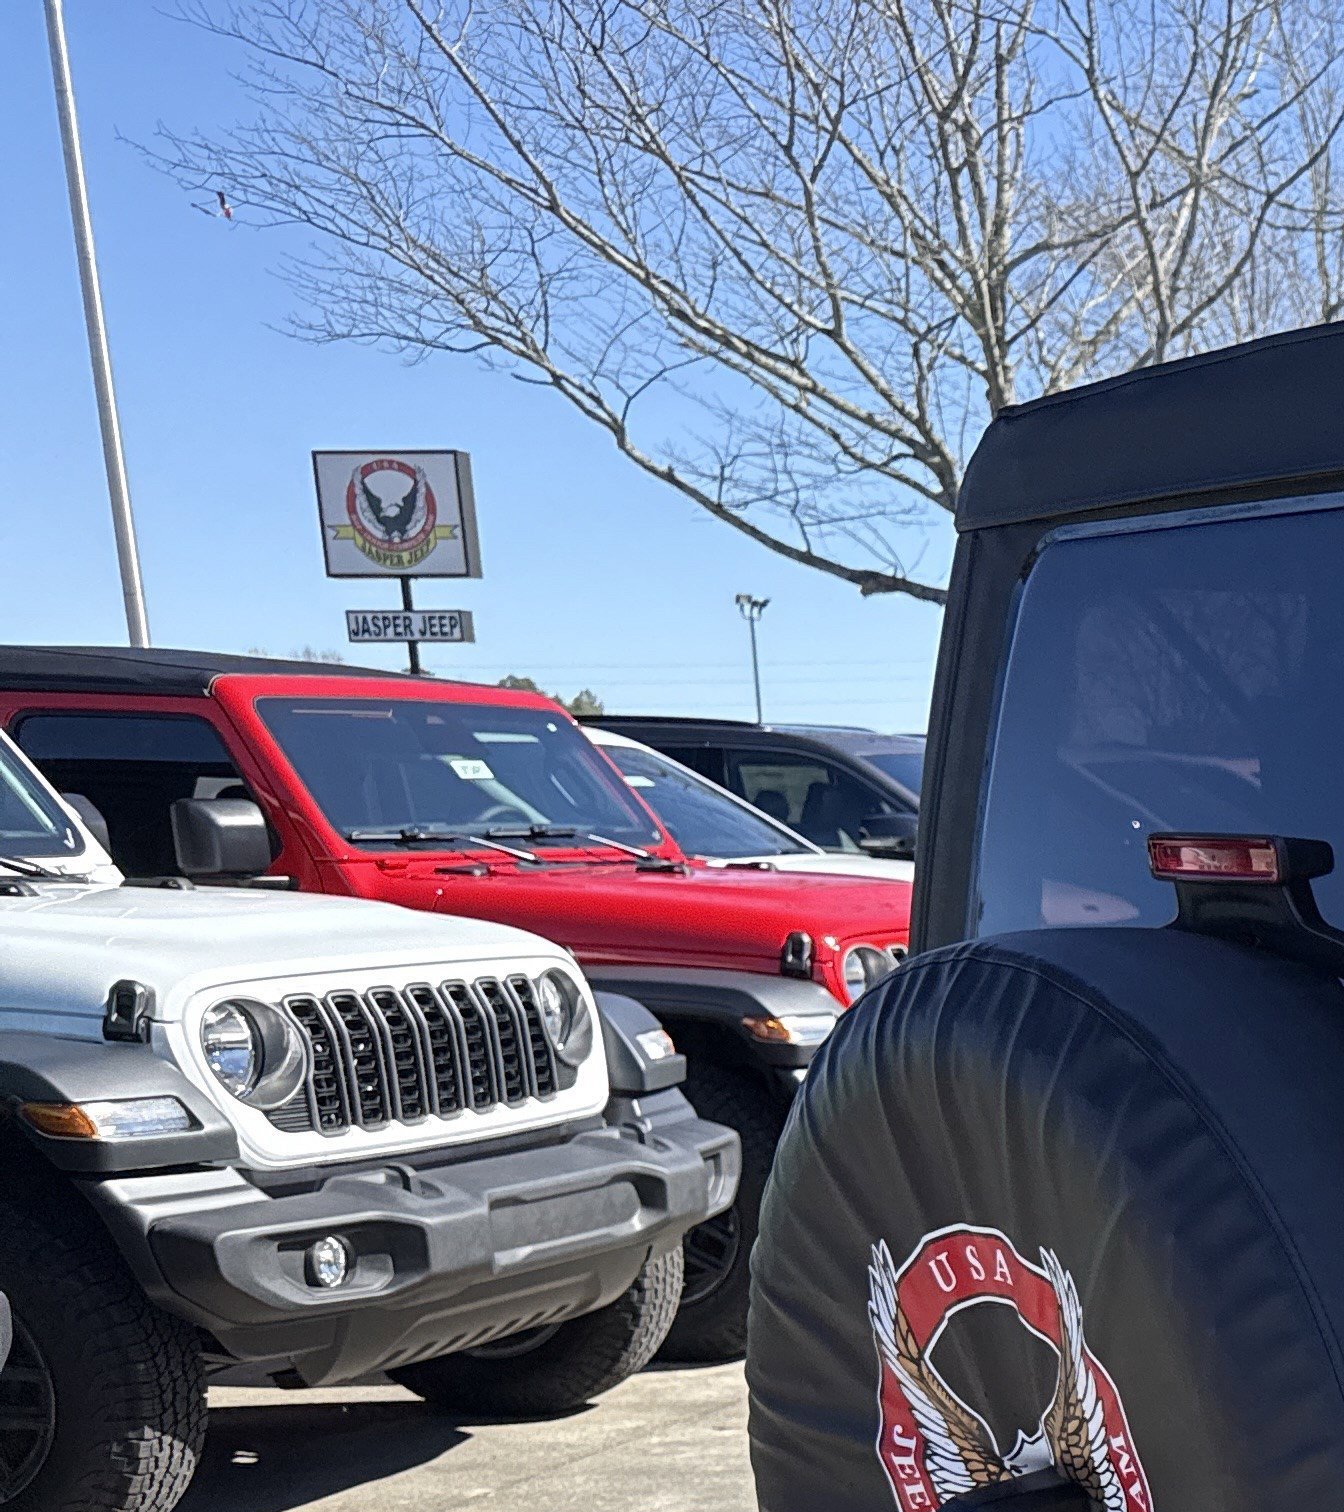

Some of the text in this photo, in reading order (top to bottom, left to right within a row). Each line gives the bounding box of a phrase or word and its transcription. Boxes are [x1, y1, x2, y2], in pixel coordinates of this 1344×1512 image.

[352, 615, 459, 637] JASPER JEEP
[928, 1245, 1013, 1292] USA
